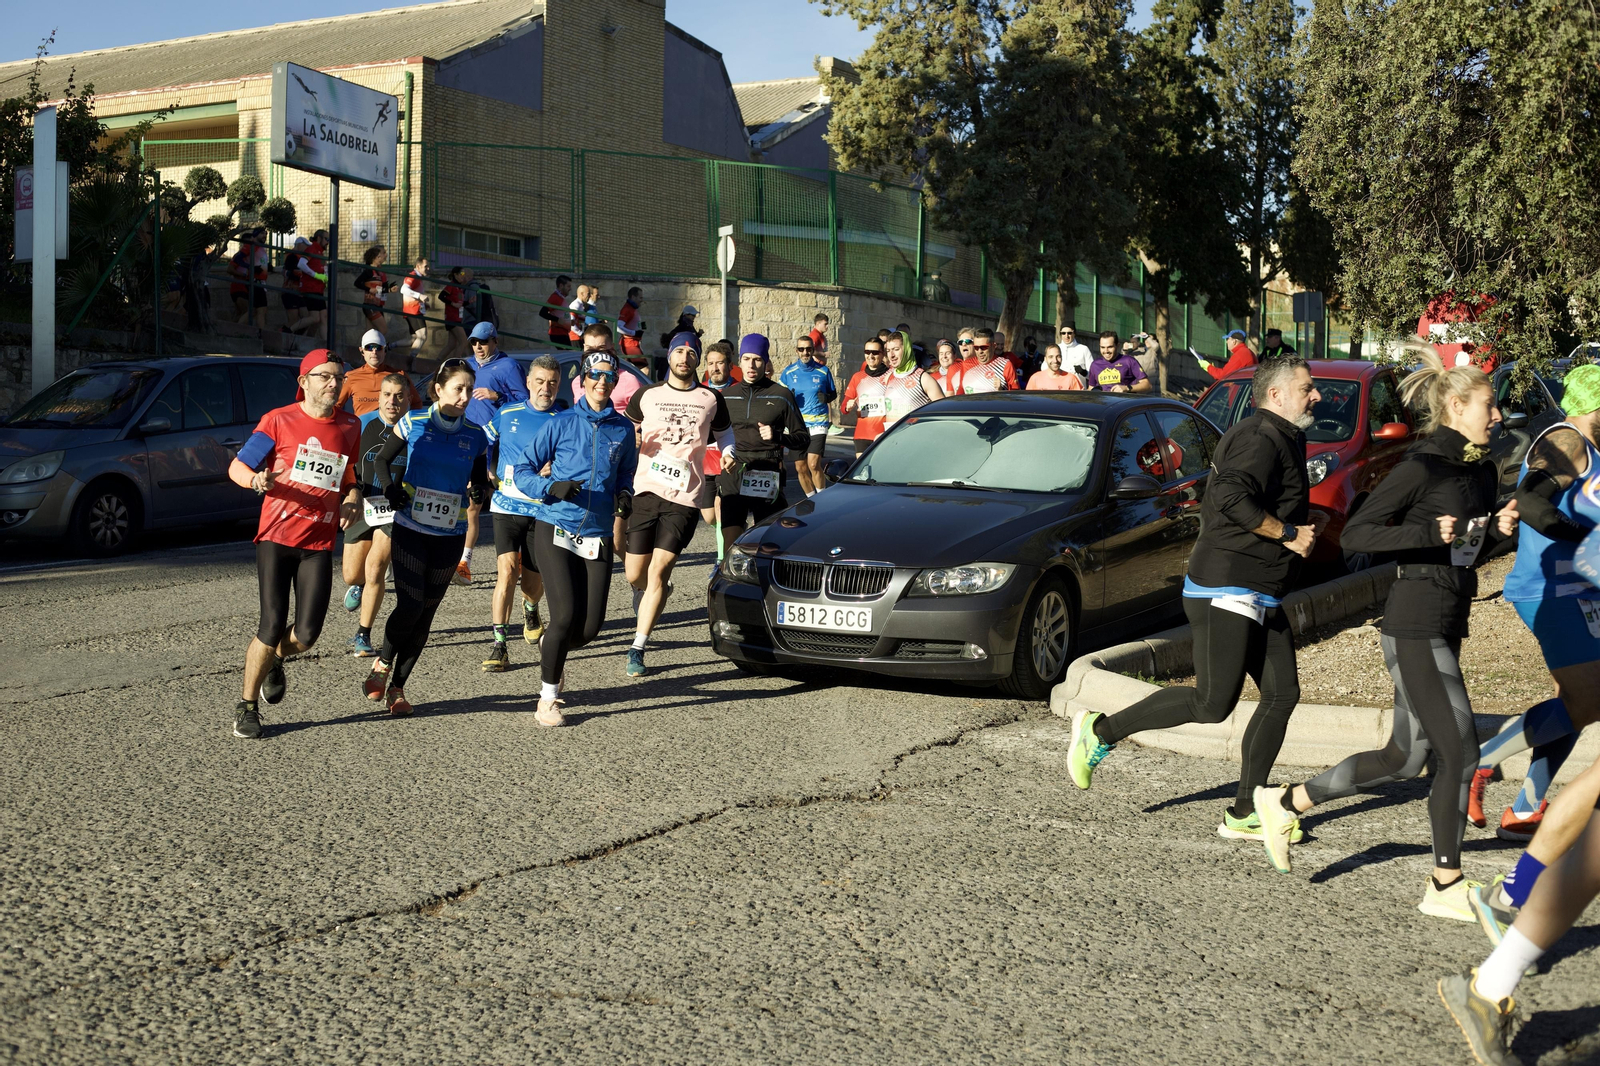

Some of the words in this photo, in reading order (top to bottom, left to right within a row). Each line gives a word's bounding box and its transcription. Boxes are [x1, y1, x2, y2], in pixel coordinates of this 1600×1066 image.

[303, 118, 316, 139] LA
[320, 123, 379, 156] SALOBREJA
[308, 460, 333, 475] 120
[660, 464, 681, 478] 218
[750, 479, 771, 488] 216
[426, 501, 450, 515] 119
[788, 605, 828, 626] 5812
[834, 609, 867, 628] GCG
